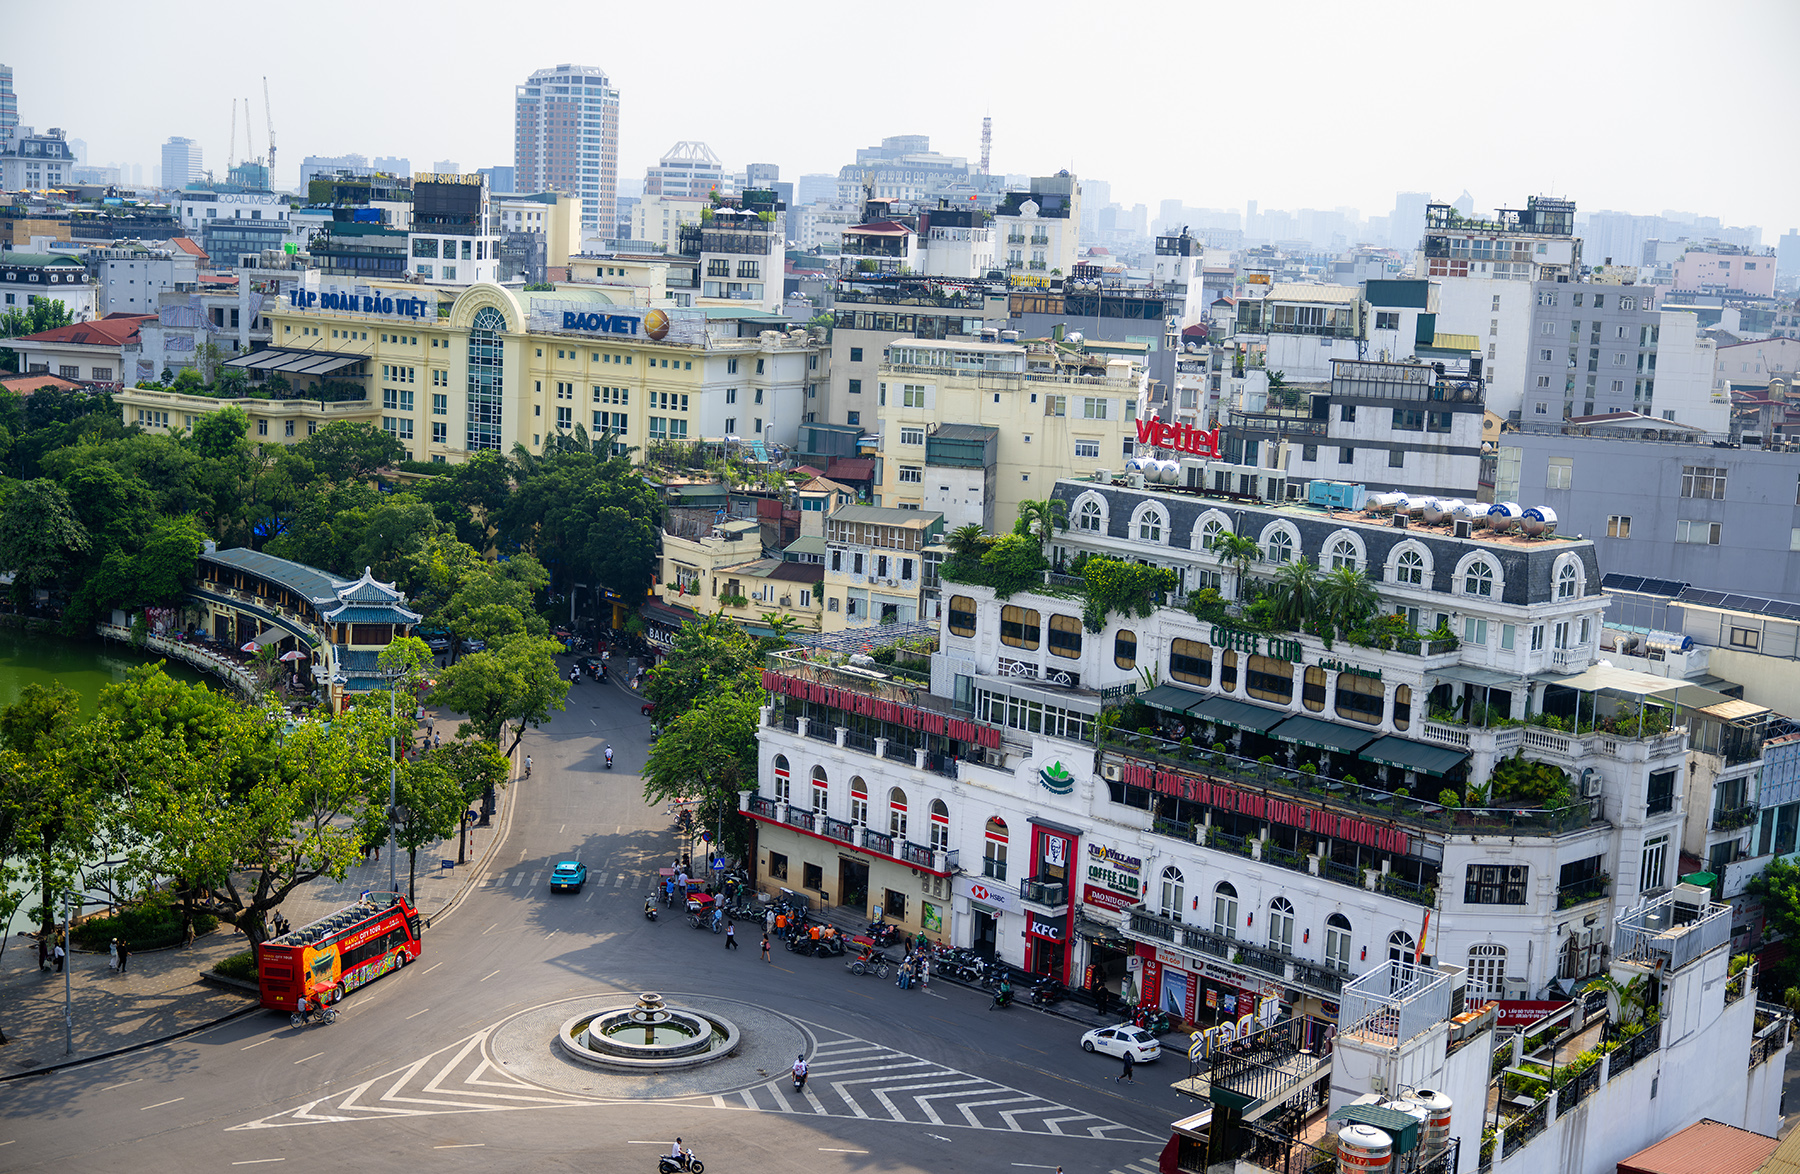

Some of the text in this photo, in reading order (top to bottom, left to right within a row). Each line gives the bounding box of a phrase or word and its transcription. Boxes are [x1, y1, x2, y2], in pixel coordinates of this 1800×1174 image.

[414, 172, 480, 186] BON SKY BAR
[218, 194, 278, 206] COALIMEX
[290, 288, 428, 320] TẬP ĐOÀN BẢO VIỆT
[563, 312, 640, 334] BAOVIET
[1135, 415, 1222, 459] viettel
[1210, 626, 1302, 663] COFFEE CLUB
[922, 712, 944, 736] NAM
[1156, 768, 1184, 798] CỘNG
[1213, 782, 1238, 814] VIỆT
[1238, 792, 1266, 818] NAM
[1267, 799, 1306, 828] QUANG
[1310, 809, 1338, 837] VINH
[1340, 816, 1376, 847] MUÔN
[1378, 824, 1408, 856] NĂM
[1088, 866, 1138, 889] COFFEE CLUB
[990, 892, 1005, 903] HSBC
[1092, 890, 1104, 900] DAO
[1105, 894, 1118, 904] NIU
[1118, 899, 1130, 908] GUO
[1030, 922, 1058, 938] KFC
[1146, 960, 1156, 969] 03
